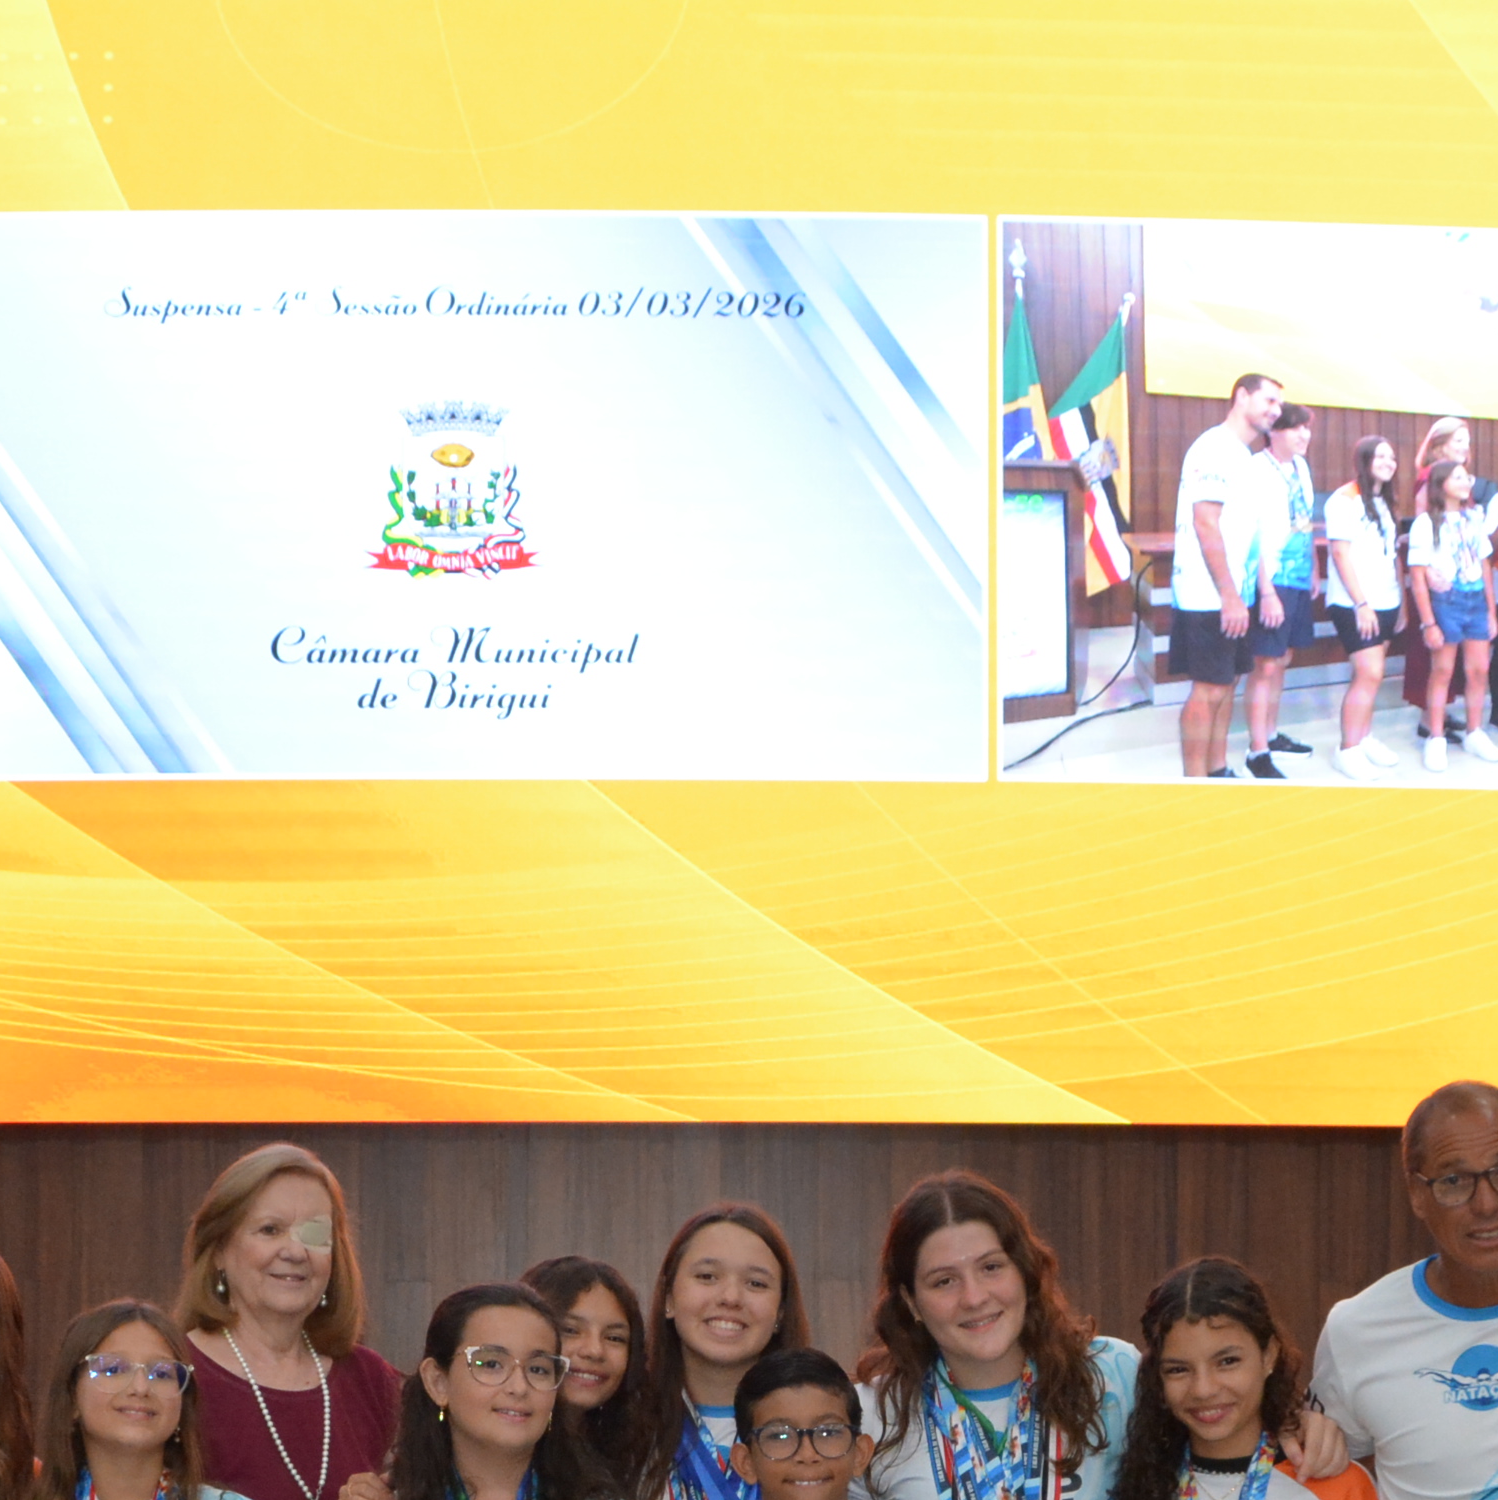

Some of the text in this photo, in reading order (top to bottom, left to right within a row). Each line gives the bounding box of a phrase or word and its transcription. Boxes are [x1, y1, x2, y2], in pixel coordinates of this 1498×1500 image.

[104, 286, 242, 324] Suspensa
[318, 285, 417, 316] Sessão
[426, 285, 569, 317] Ordinária
[578, 287, 805, 319] 03/03/2026
[387, 544, 519, 571] LABOR OMNIA VINCIT
[270, 625, 639, 673] Câmara Municipal
[357, 669, 552, 720] de Birigui
